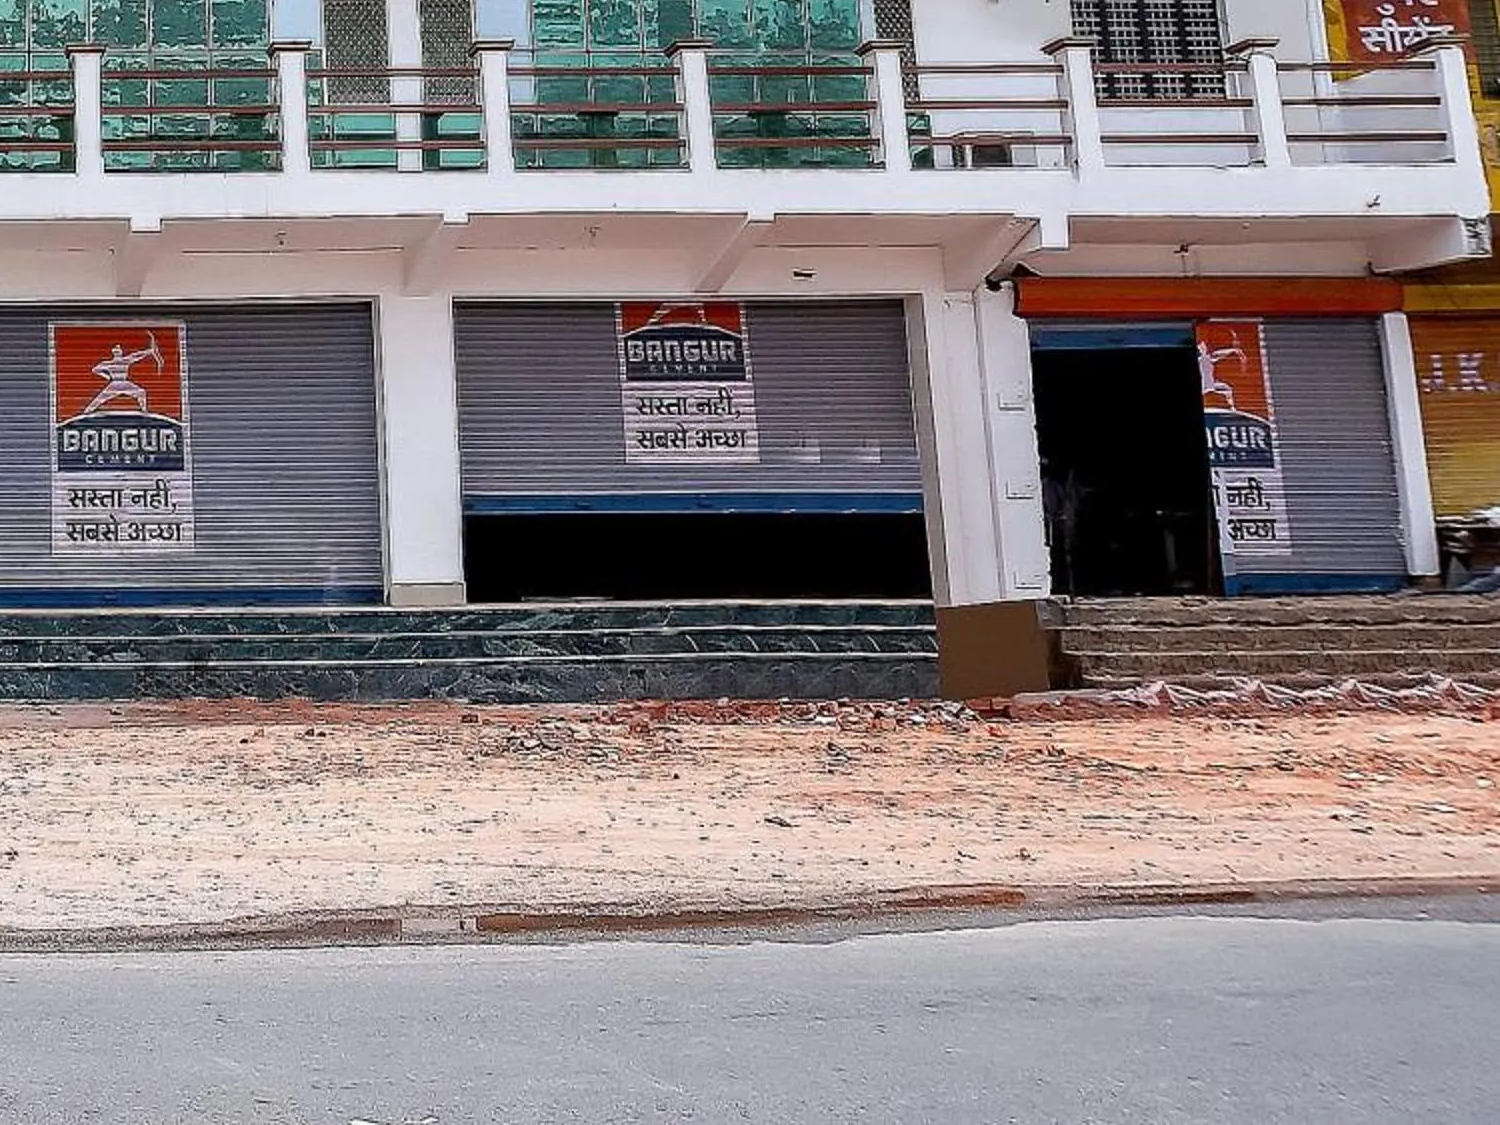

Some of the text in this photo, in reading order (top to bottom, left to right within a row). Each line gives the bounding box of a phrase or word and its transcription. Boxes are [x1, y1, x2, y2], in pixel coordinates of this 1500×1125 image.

[627, 340, 736, 362] BANGUR
[636, 396, 689, 415] सस्ता
[63, 428, 177, 452] BANGUR
[636, 422, 747, 448] सबसे अच्छा
[68, 488, 124, 508] सस्ता
[66, 513, 182, 542] सबसे अच्छा
